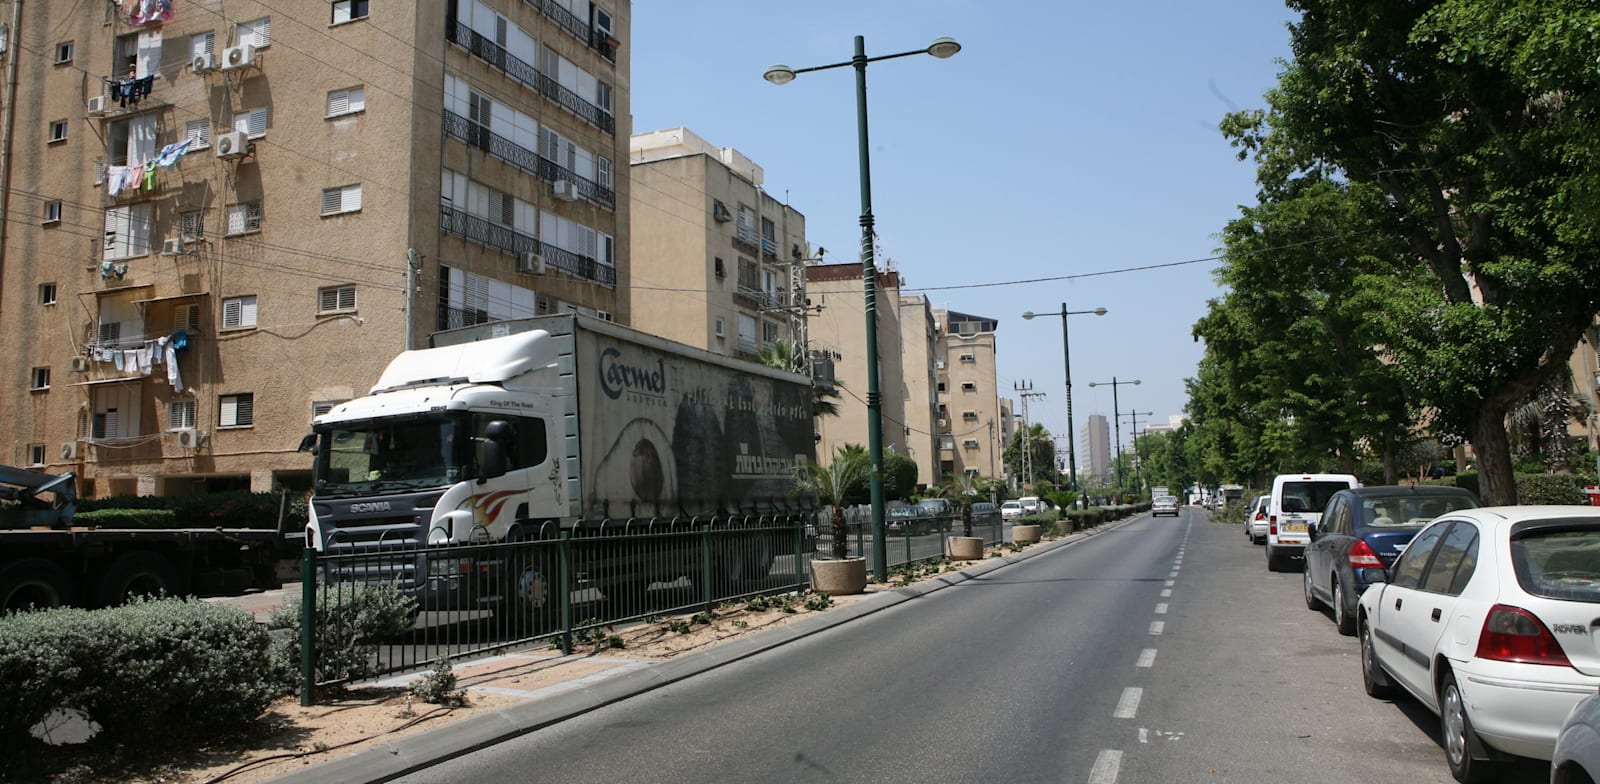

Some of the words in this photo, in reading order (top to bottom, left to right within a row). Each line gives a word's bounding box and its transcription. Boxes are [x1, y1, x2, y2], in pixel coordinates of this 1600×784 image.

[599, 347, 666, 400] Carmel
[350, 501, 392, 513] SCANIA
[1553, 623, 1588, 636] ROVER
